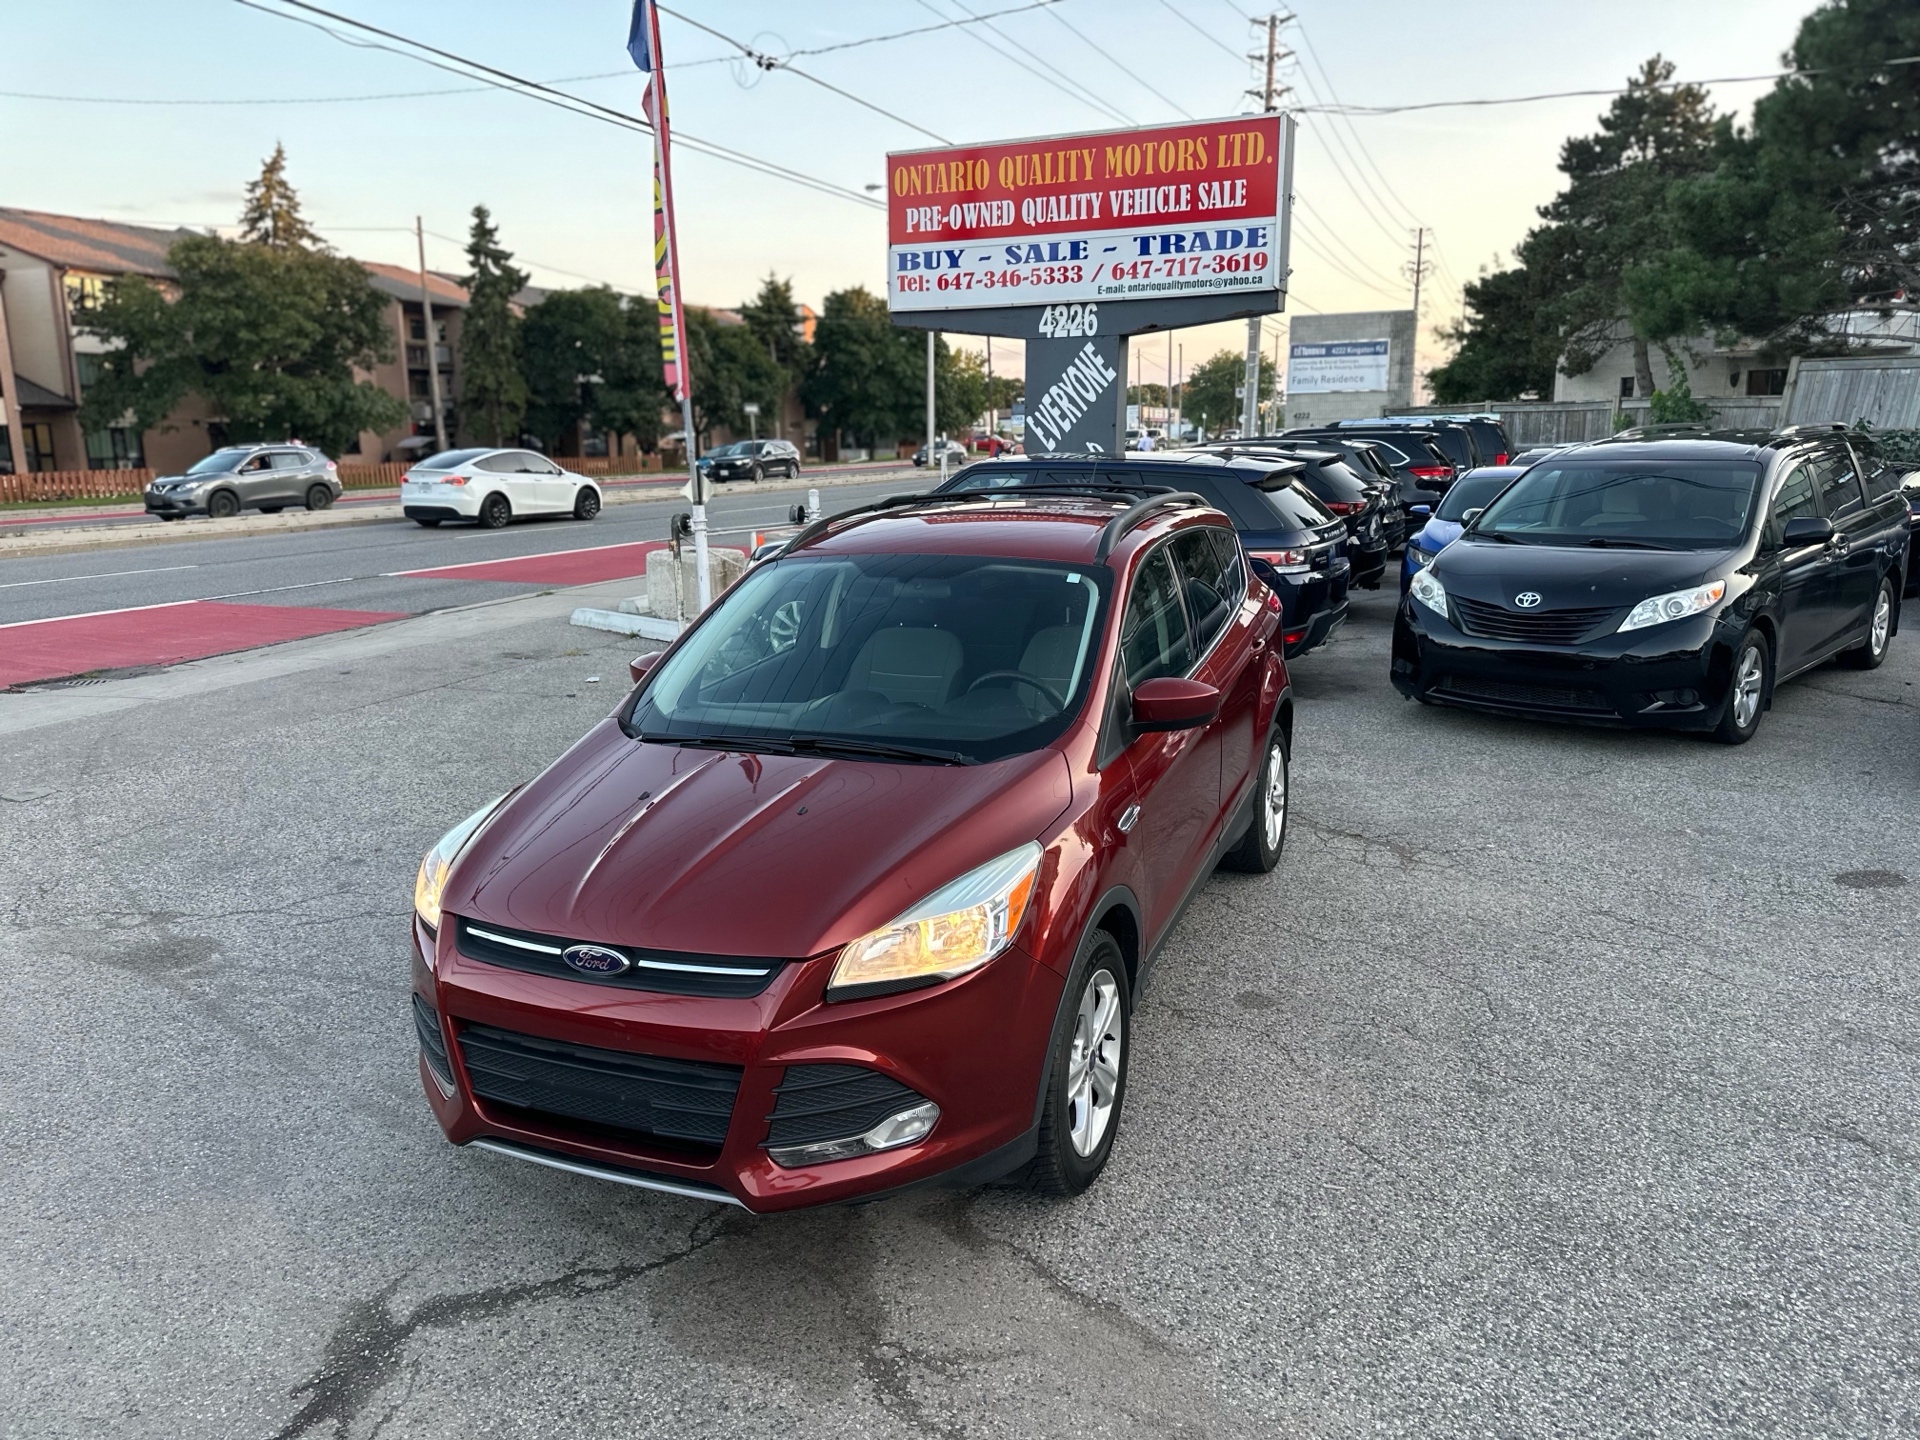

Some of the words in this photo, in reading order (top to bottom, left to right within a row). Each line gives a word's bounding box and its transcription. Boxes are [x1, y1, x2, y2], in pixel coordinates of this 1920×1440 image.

[894, 158, 990, 197] ONTARIO
[998, 148, 1097, 191] QUALITY
[1105, 136, 1208, 179] MOTORS
[1217, 131, 1273, 169] LTD.
[906, 200, 1016, 233] PRE-OWNED
[1021, 192, 1103, 227] QUALITY
[1109, 184, 1192, 217] VEHICLE
[1198, 179, 1247, 210] SALE
[897, 249, 966, 272] BUY
[1005, 240, 1089, 265] SALE
[1132, 226, 1268, 257] TRADE
[897, 274, 930, 292] Tel:
[937, 265, 1084, 291] 647-346-5333
[1090, 263, 1105, 283] /
[1111, 251, 1269, 281] 647-717-3619
[1097, 283, 1126, 295] E-mail:
[1127, 275, 1263, 293] ontarioqualitymotors@yahoo.ca
[1038, 303, 1098, 338] 4226
[1331, 347, 1346, 355] 4222
[1346, 346, 1375, 355] Kingston
[1375, 344, 1385, 353] Rd
[1026, 341, 1117, 452] EVERYONE
[1292, 375, 1318, 386] Family
[1321, 374, 1365, 384] Residence
[575, 949, 611, 970] Ford
